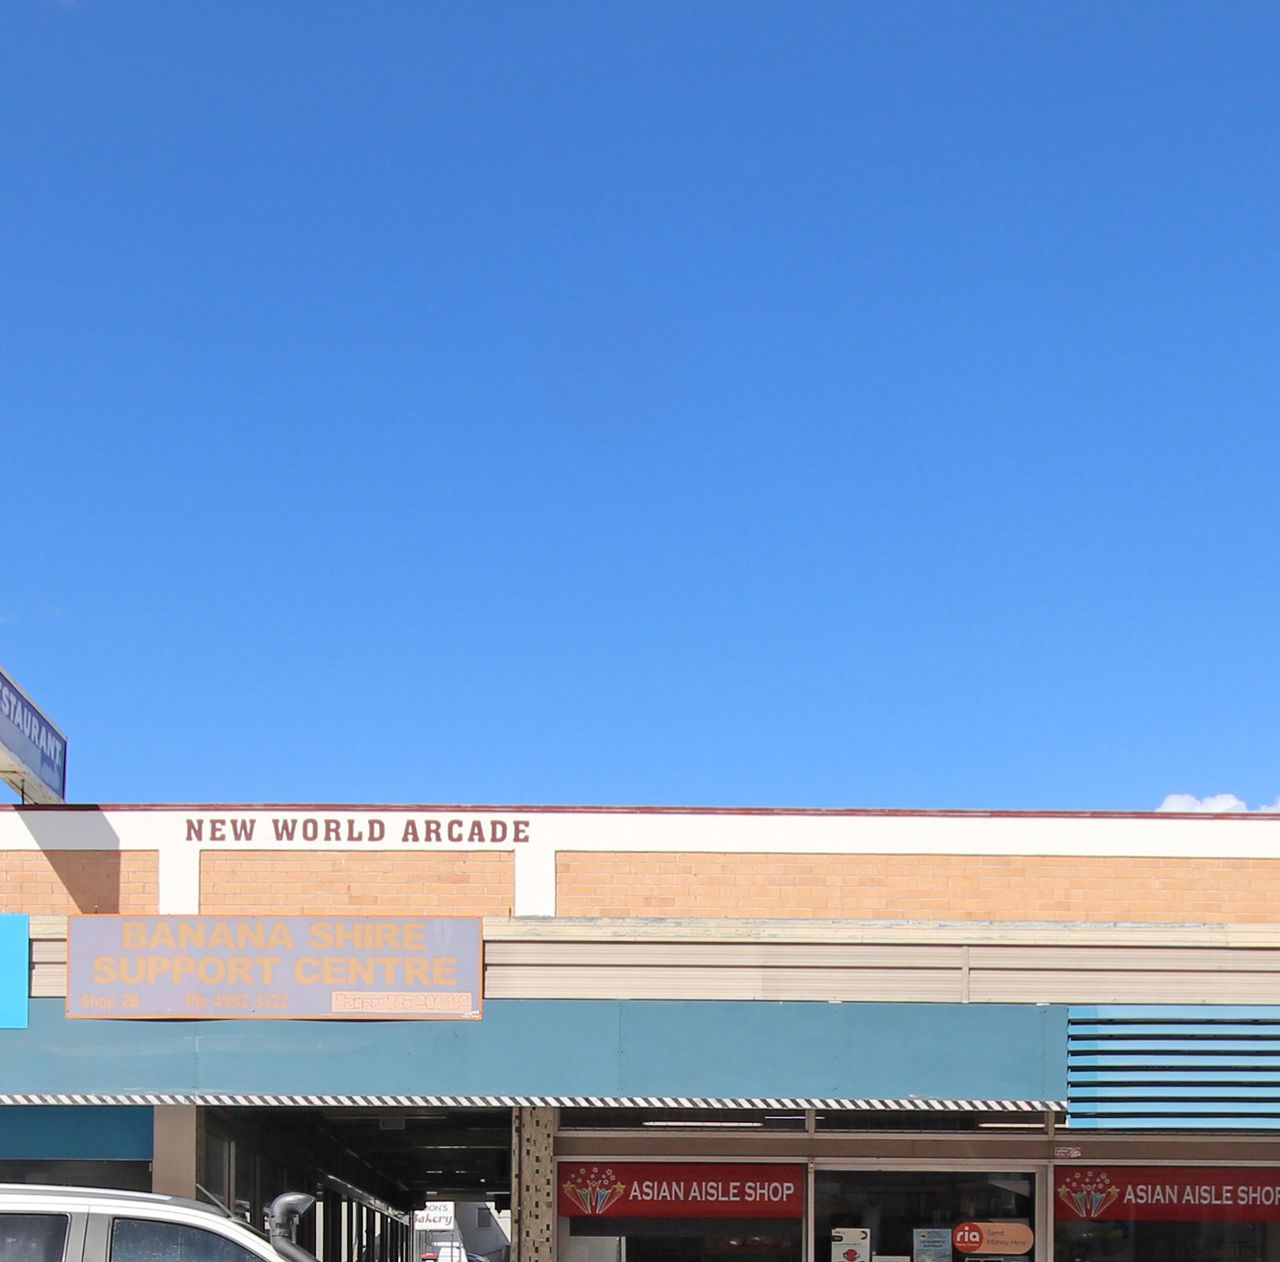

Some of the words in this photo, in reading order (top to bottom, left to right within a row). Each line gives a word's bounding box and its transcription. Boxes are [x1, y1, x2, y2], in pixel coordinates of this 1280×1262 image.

[186, 819, 256, 841] NEW
[272, 819, 385, 841] WORLD
[402, 820, 530, 842] ARCADE
[122, 921, 293, 949] BANANA
[309, 922, 427, 949] SHIRE
[93, 955, 279, 985] SUPPORT
[294, 956, 457, 985] CENTRE
[629, 1181, 684, 1200] ASIAN
[688, 1181, 740, 1201] AISLE
[744, 1182, 795, 1202] SHOP
[1123, 1184, 1178, 1204] ASIAN
[1182, 1185, 1233, 1205] AISLE
[956, 1225, 980, 1242] ria
